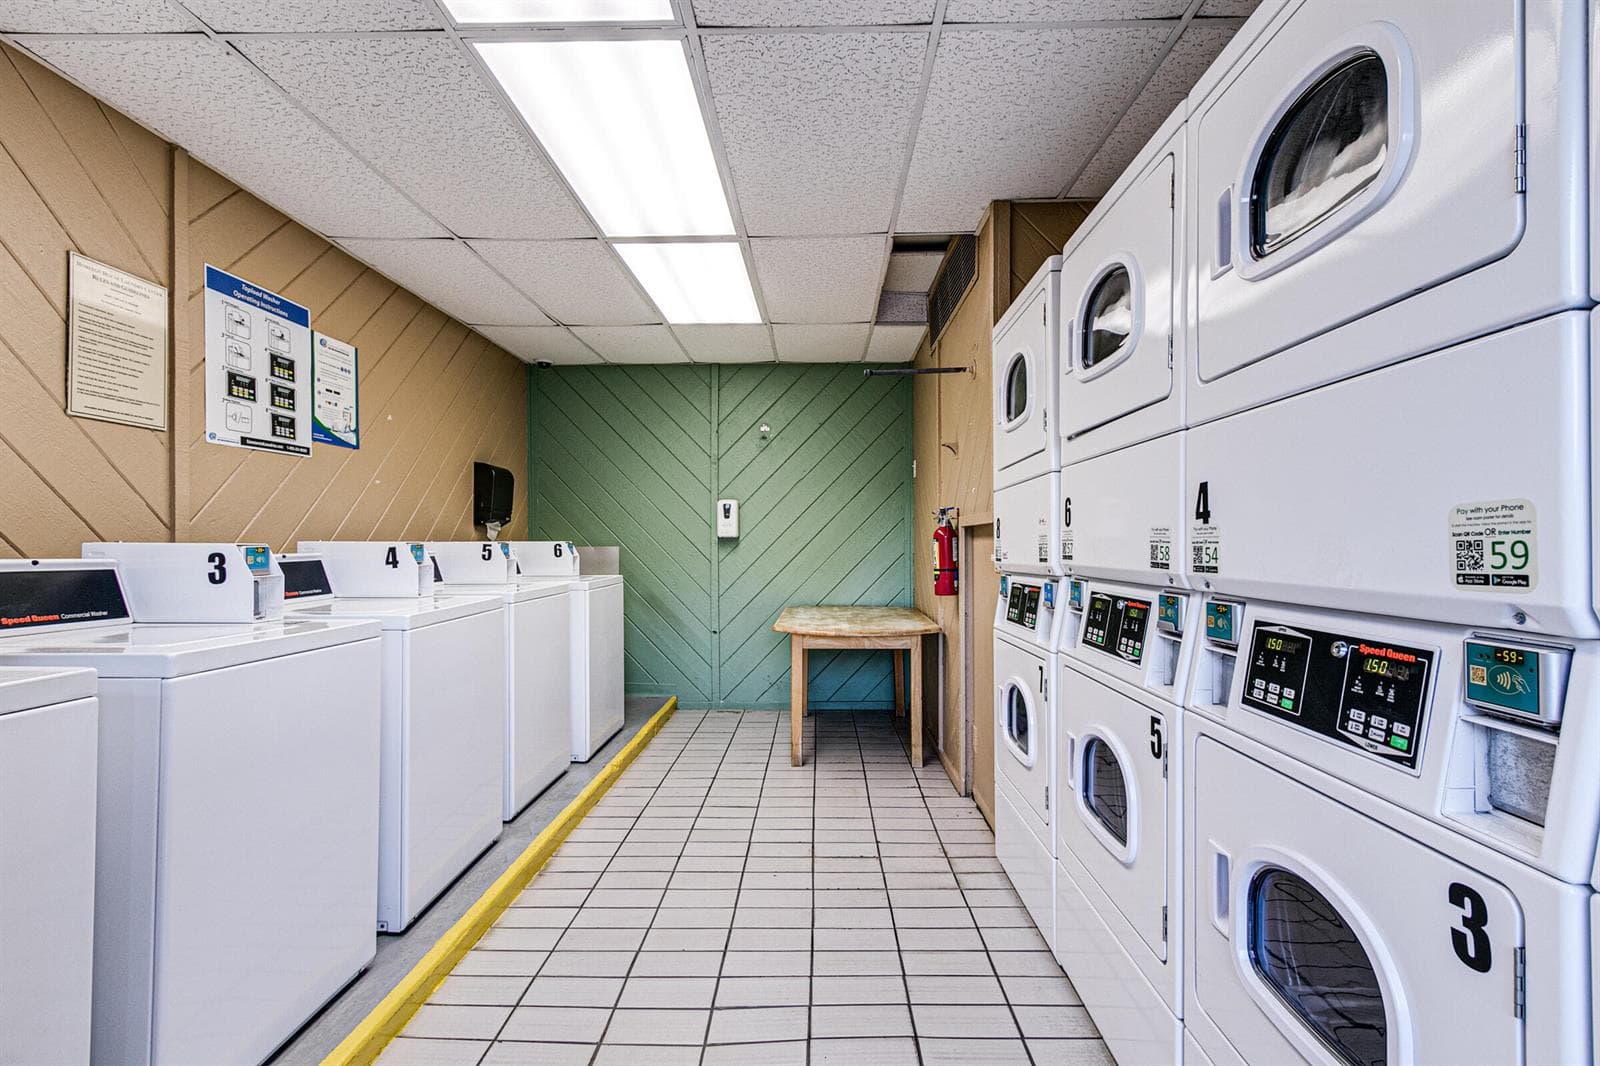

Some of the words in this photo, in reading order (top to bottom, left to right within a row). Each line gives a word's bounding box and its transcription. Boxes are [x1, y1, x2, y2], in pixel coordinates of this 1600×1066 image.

[233, 289, 260, 307] Operating
[260, 302, 288, 318] Instructions
[241, 283, 262, 298] Topload
[262, 293, 281, 305] Washer
[1064, 497, 1072, 527] 6
[1195, 481, 1211, 525] 4
[1456, 507, 1468, 515] Pay
[1484, 506, 1499, 514] your
[996, 517, 1001, 538] 8
[1484, 528, 1497, 536] OR
[385, 546, 400, 569] 4
[481, 543, 493, 561] 5
[553, 543, 563, 558] 6
[1159, 545, 1170, 561] 58
[1205, 546, 1219, 564] 54
[1490, 540, 1529, 570] 59
[208, 552, 227, 585] 3
[1, 615, 31, 625] Speed
[31, 614, 60, 622] Queen
[60, 611, 90, 620] Commercial
[1359, 643, 1386, 656] Speed
[1386, 648, 1416, 662] Queen
[1038, 665, 1044, 693] 7
[1150, 715, 1162, 760] 5
[1364, 741, 1379, 751] LOWER
[1448, 882, 1493, 974] 3
